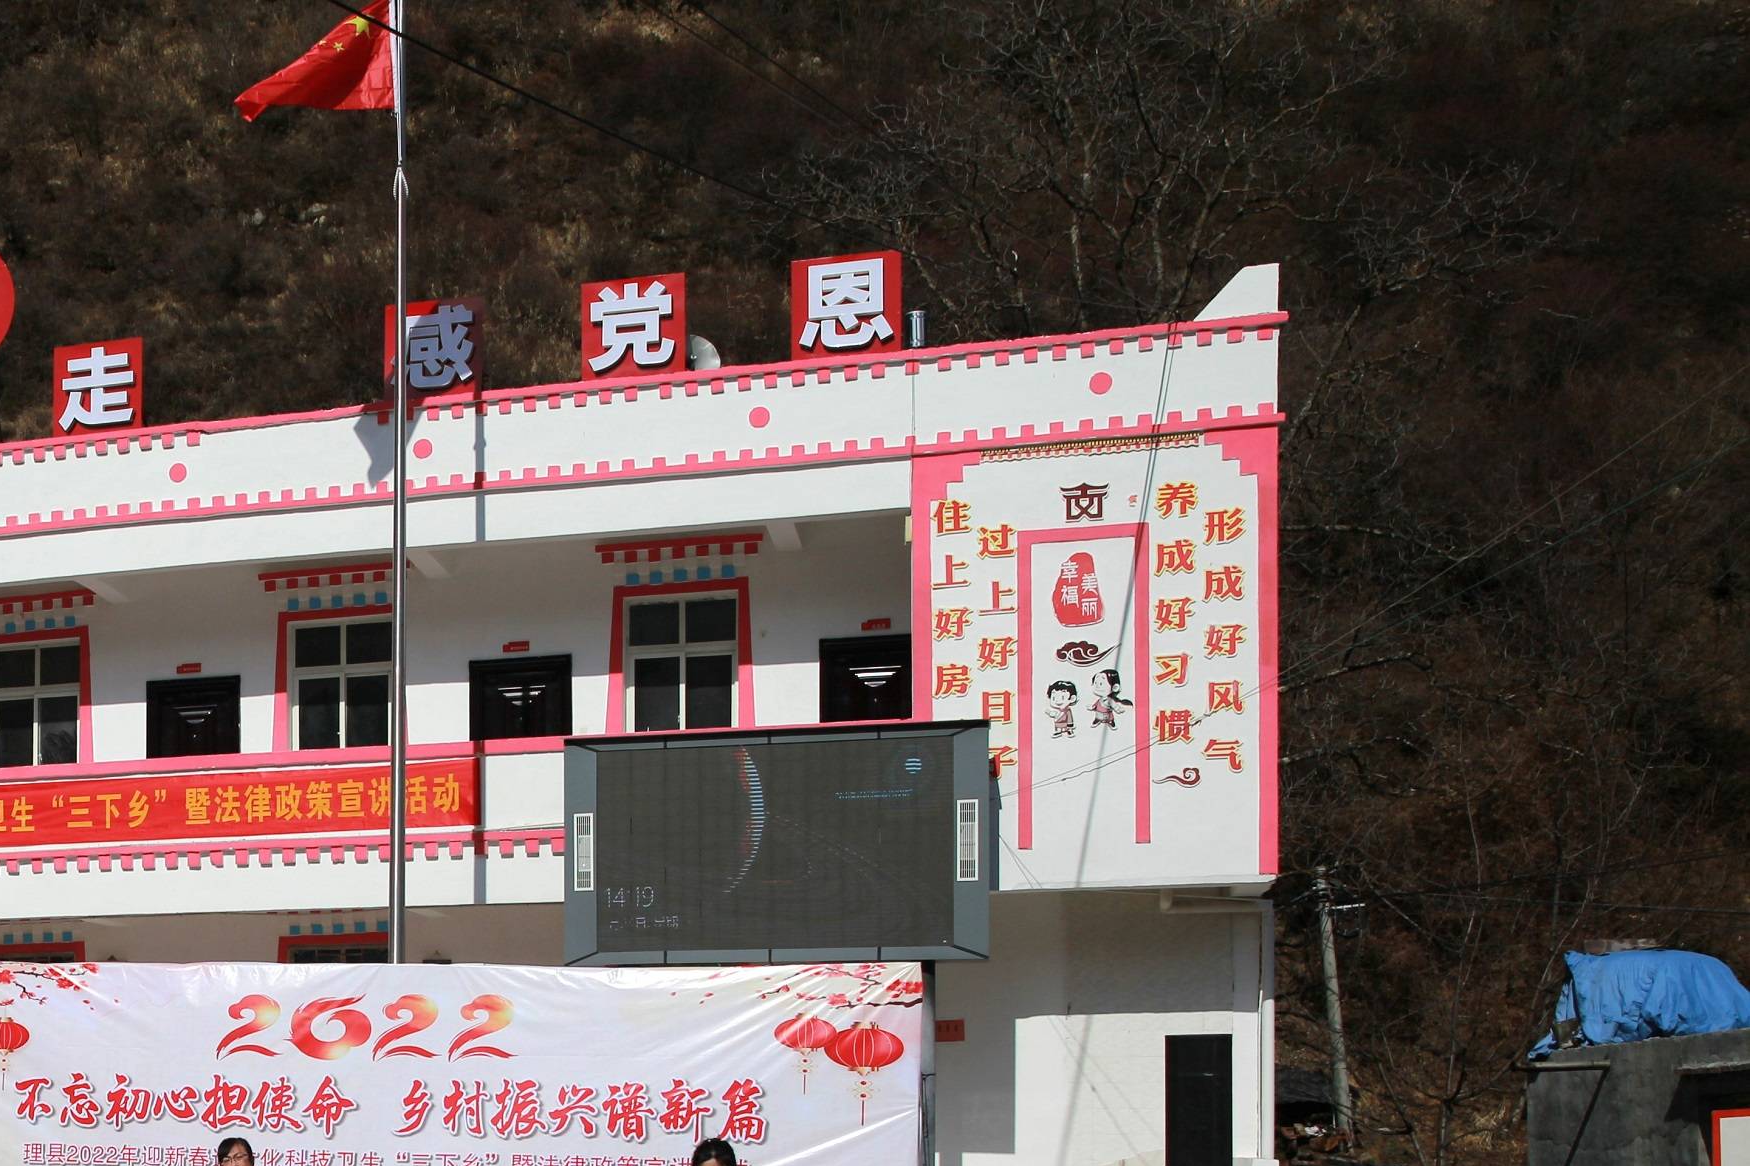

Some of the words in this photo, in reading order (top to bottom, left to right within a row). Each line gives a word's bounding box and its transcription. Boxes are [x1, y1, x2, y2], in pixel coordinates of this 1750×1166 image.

[390, 258, 891, 389] 感党恩
[932, 500, 971, 700] 住上好房
[1060, 560, 1079, 609] 幸福
[1081, 573, 1100, 619] 美丽
[1154, 482, 1198, 746] 养成好习惯
[1203, 507, 1246, 773] 形成好风气
[977, 524, 1018, 782] 过上好日子
[213, 992, 518, 1061] 2022
[14, 1072, 355, 1132] 不忘初心担使命
[393, 1077, 766, 1142] 乡村振兴谱新篇
